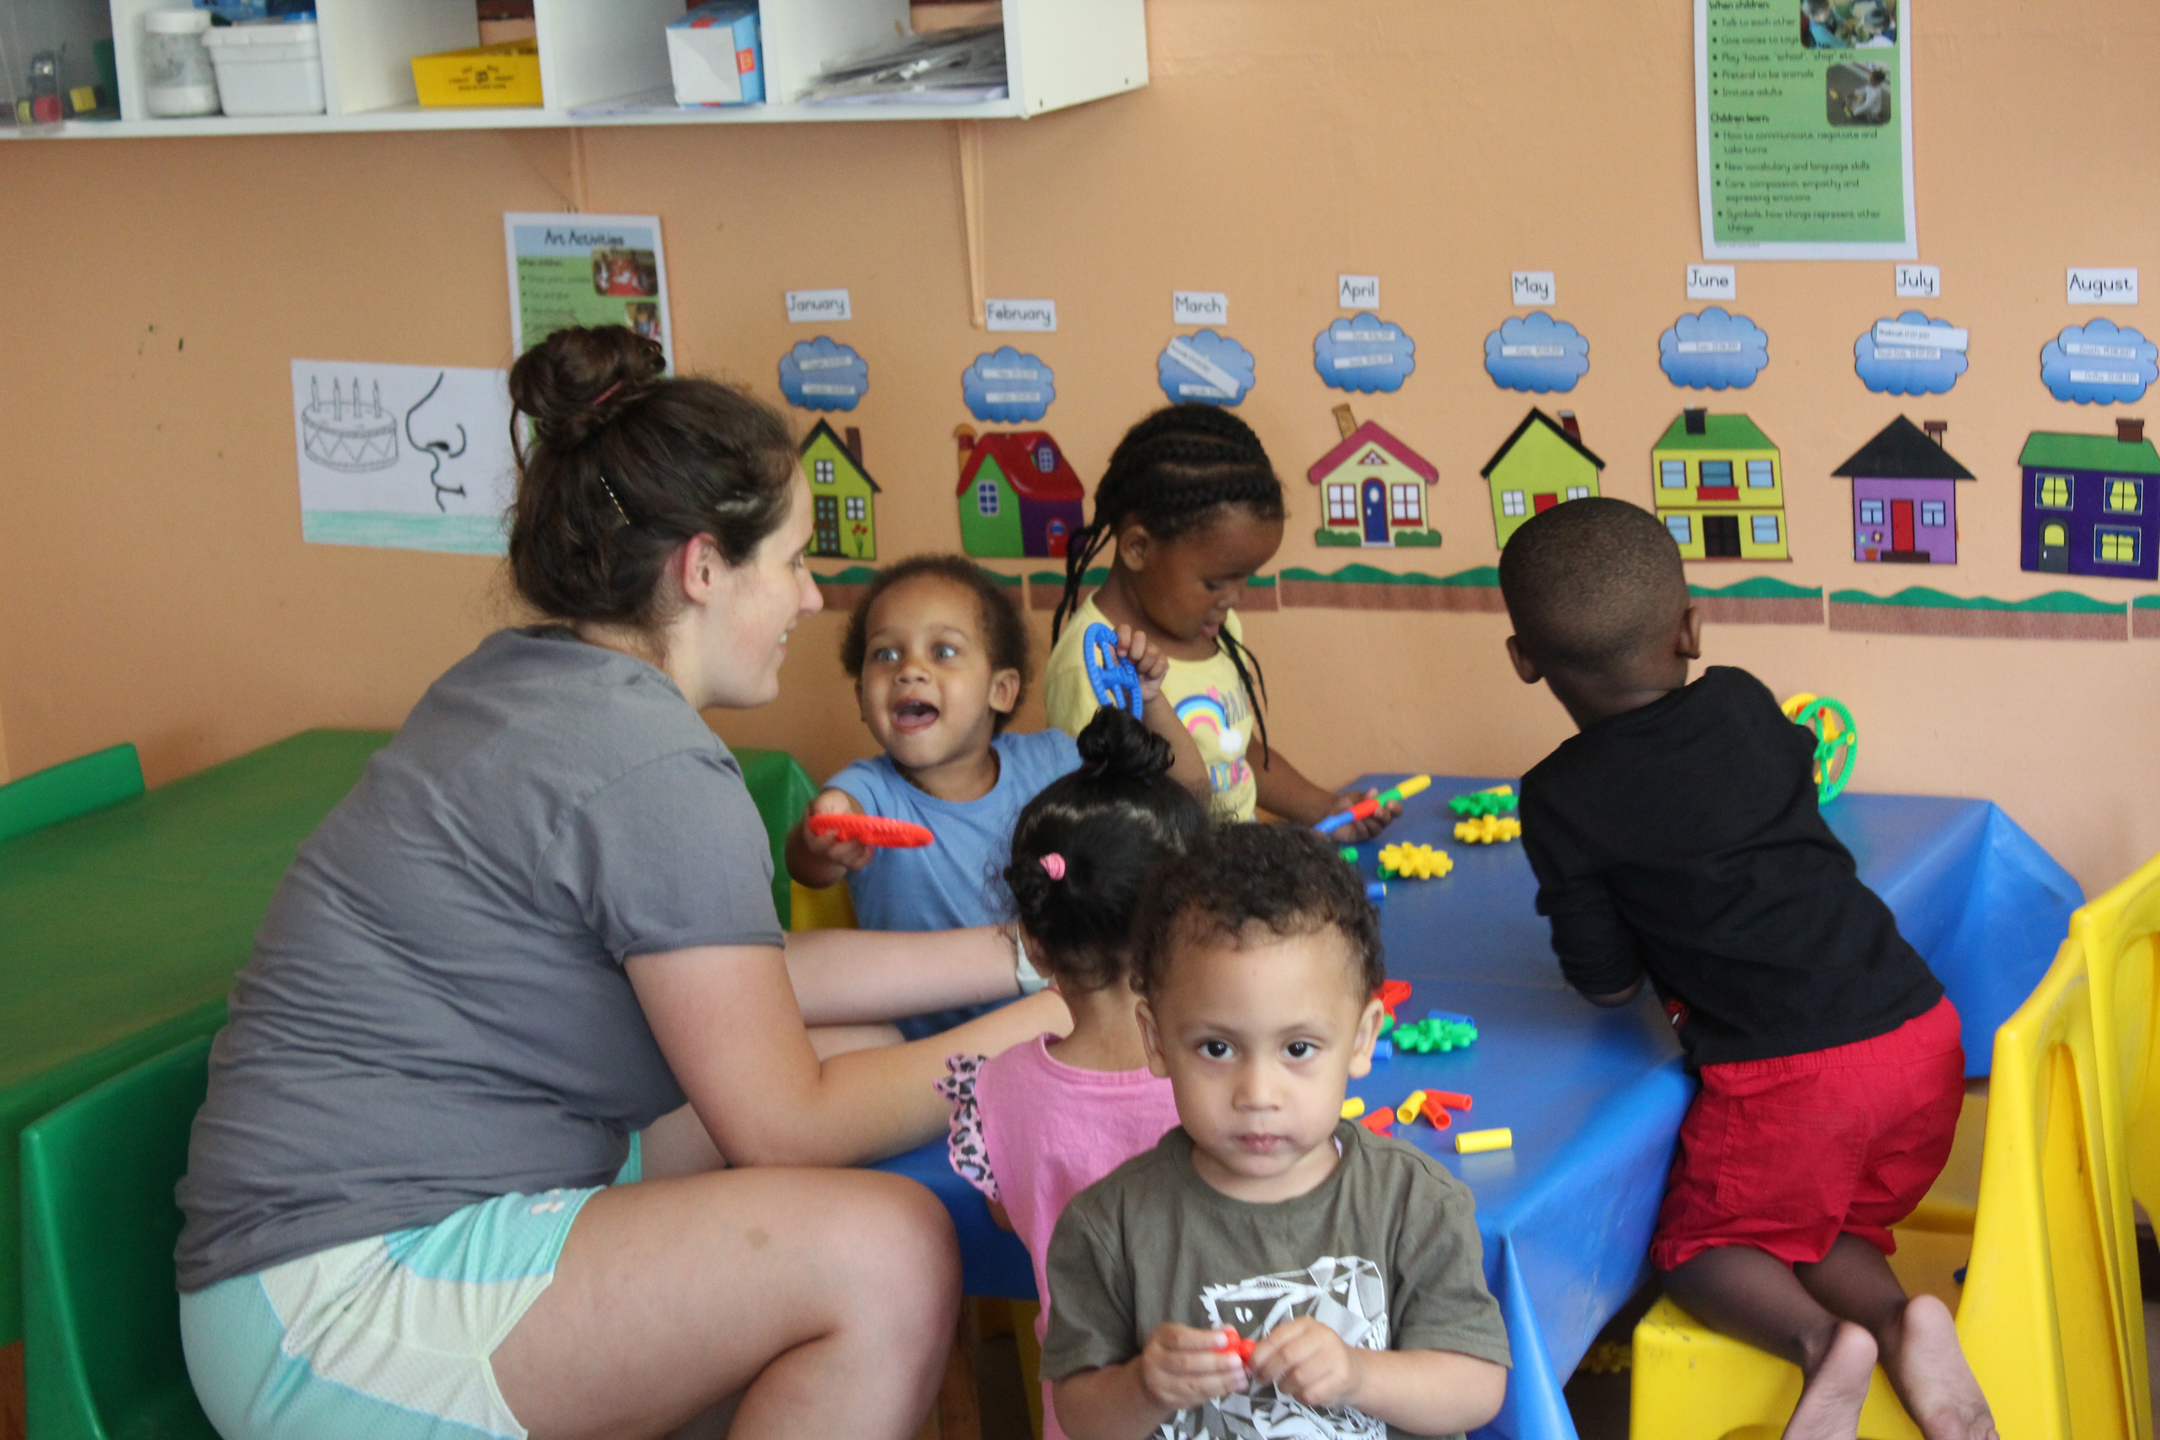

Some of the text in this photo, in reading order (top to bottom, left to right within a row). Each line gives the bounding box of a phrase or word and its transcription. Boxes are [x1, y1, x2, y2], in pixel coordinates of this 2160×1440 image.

[1722, 17, 1737, 26] Talk
[1740, 18, 1749, 26] to
[1773, 16, 1794, 26] other
[1768, 36, 1778, 44] to
[1722, 52, 1739, 64] Play
[1722, 69, 1755, 79] Pretend
[1757, 70, 1767, 78] to
[1769, 69, 1779, 78] be
[1756, 86, 1783, 96] adults
[1710, 112, 1744, 123] Children
[1723, 131, 1742, 140] How
[1744, 131, 1754, 139] to
[1817, 131, 1859, 142] negotiate
[1861, 129, 1878, 139] and
[1724, 145, 1768, 154] take turns
[1724, 160, 1870, 173] New vocabulary and language skills
[1802, 178, 1841, 191] empathy
[1843, 178, 1859, 188] and
[1726, 194, 1811, 205] expressing emotions
[1765, 209, 1784, 218] how
[1785, 209, 1811, 221] things
[1813, 210, 1855, 222] represent
[1857, 208, 1880, 218] other
[1727, 223, 1754, 235] things
[545, 228, 625, 247] Art Activities
[1688, 268, 1729, 288] June
[1898, 268, 1933, 296] July
[1341, 279, 1375, 303] April
[1514, 275, 1549, 301] May
[2069, 272, 2133, 299] August
[788, 295, 845, 316] January
[1174, 296, 1222, 313] March
[987, 302, 1051, 327] February
